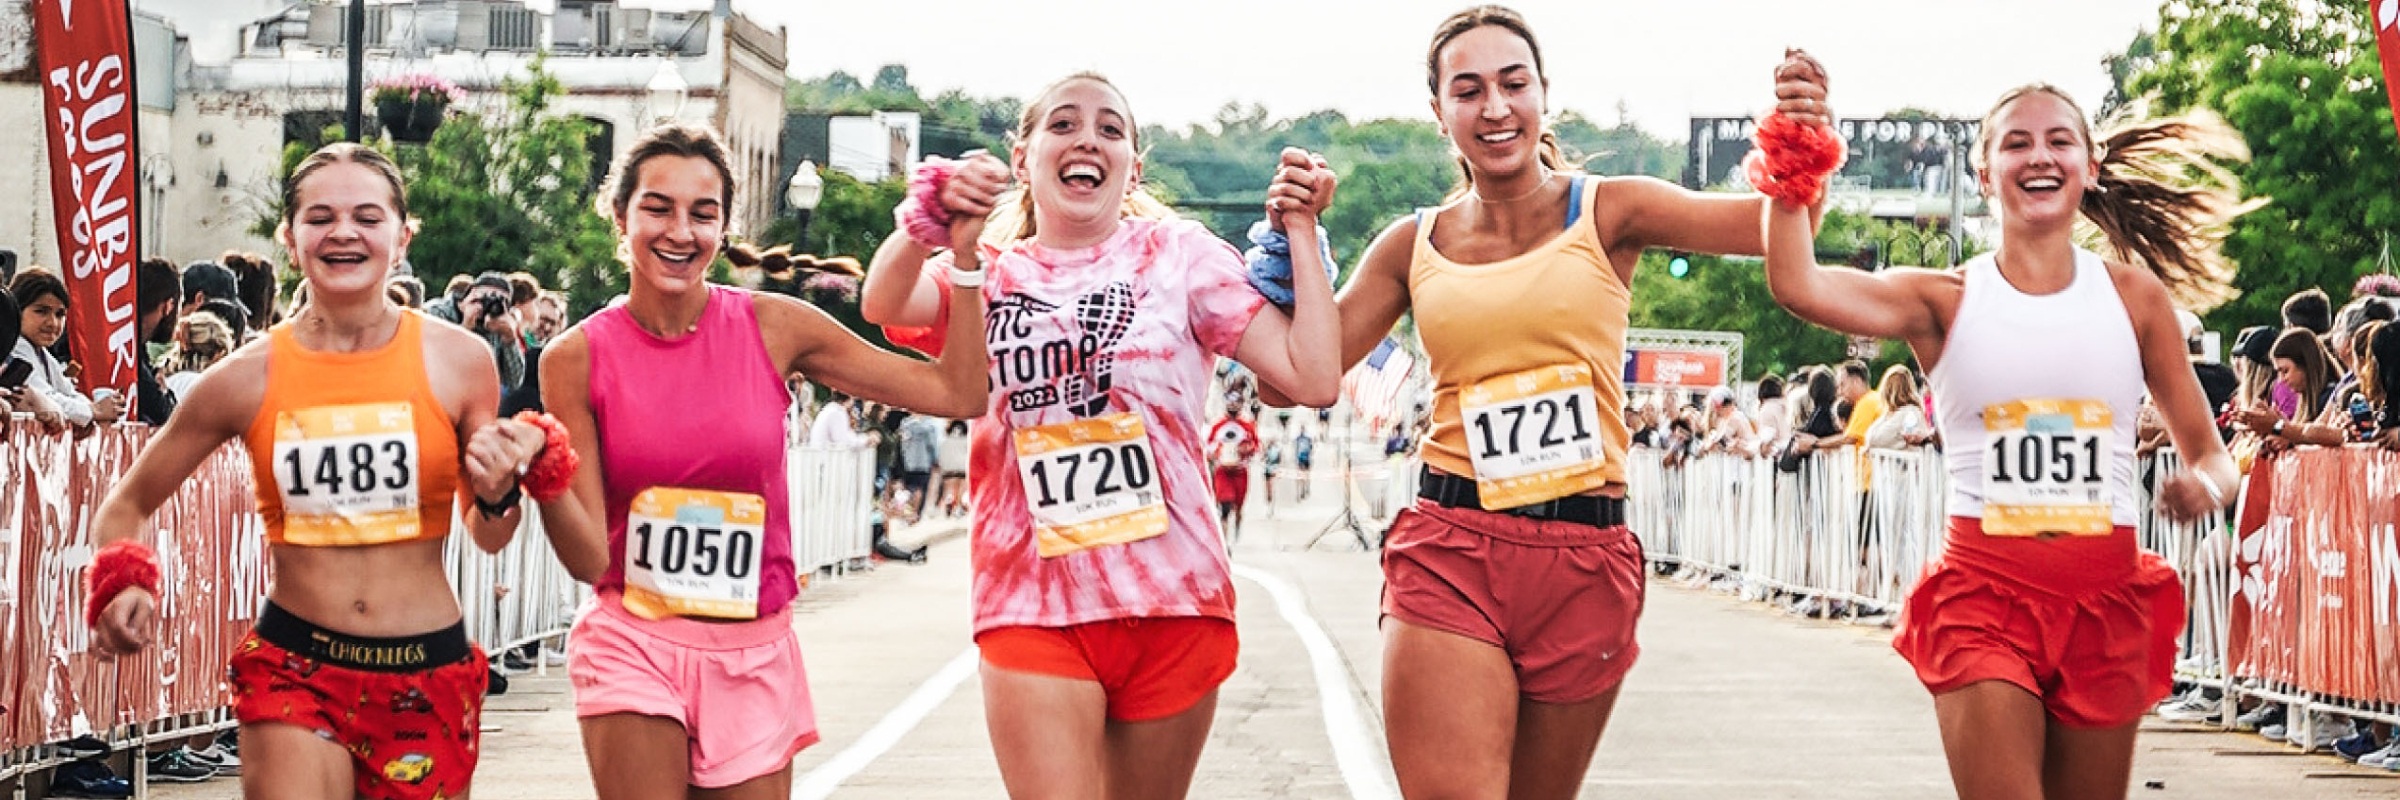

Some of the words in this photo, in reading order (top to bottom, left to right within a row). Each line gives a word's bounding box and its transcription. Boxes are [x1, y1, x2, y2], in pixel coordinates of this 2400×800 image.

[1861, 120, 1912, 142] FOR
[985, 334, 1097, 393] TOMP
[1475, 394, 1591, 460] 1721
[284, 440, 409, 496] 1483
[1031, 444, 1150, 507] 1720
[1992, 436, 2103, 483] 1051
[634, 523, 753, 579] 1050
